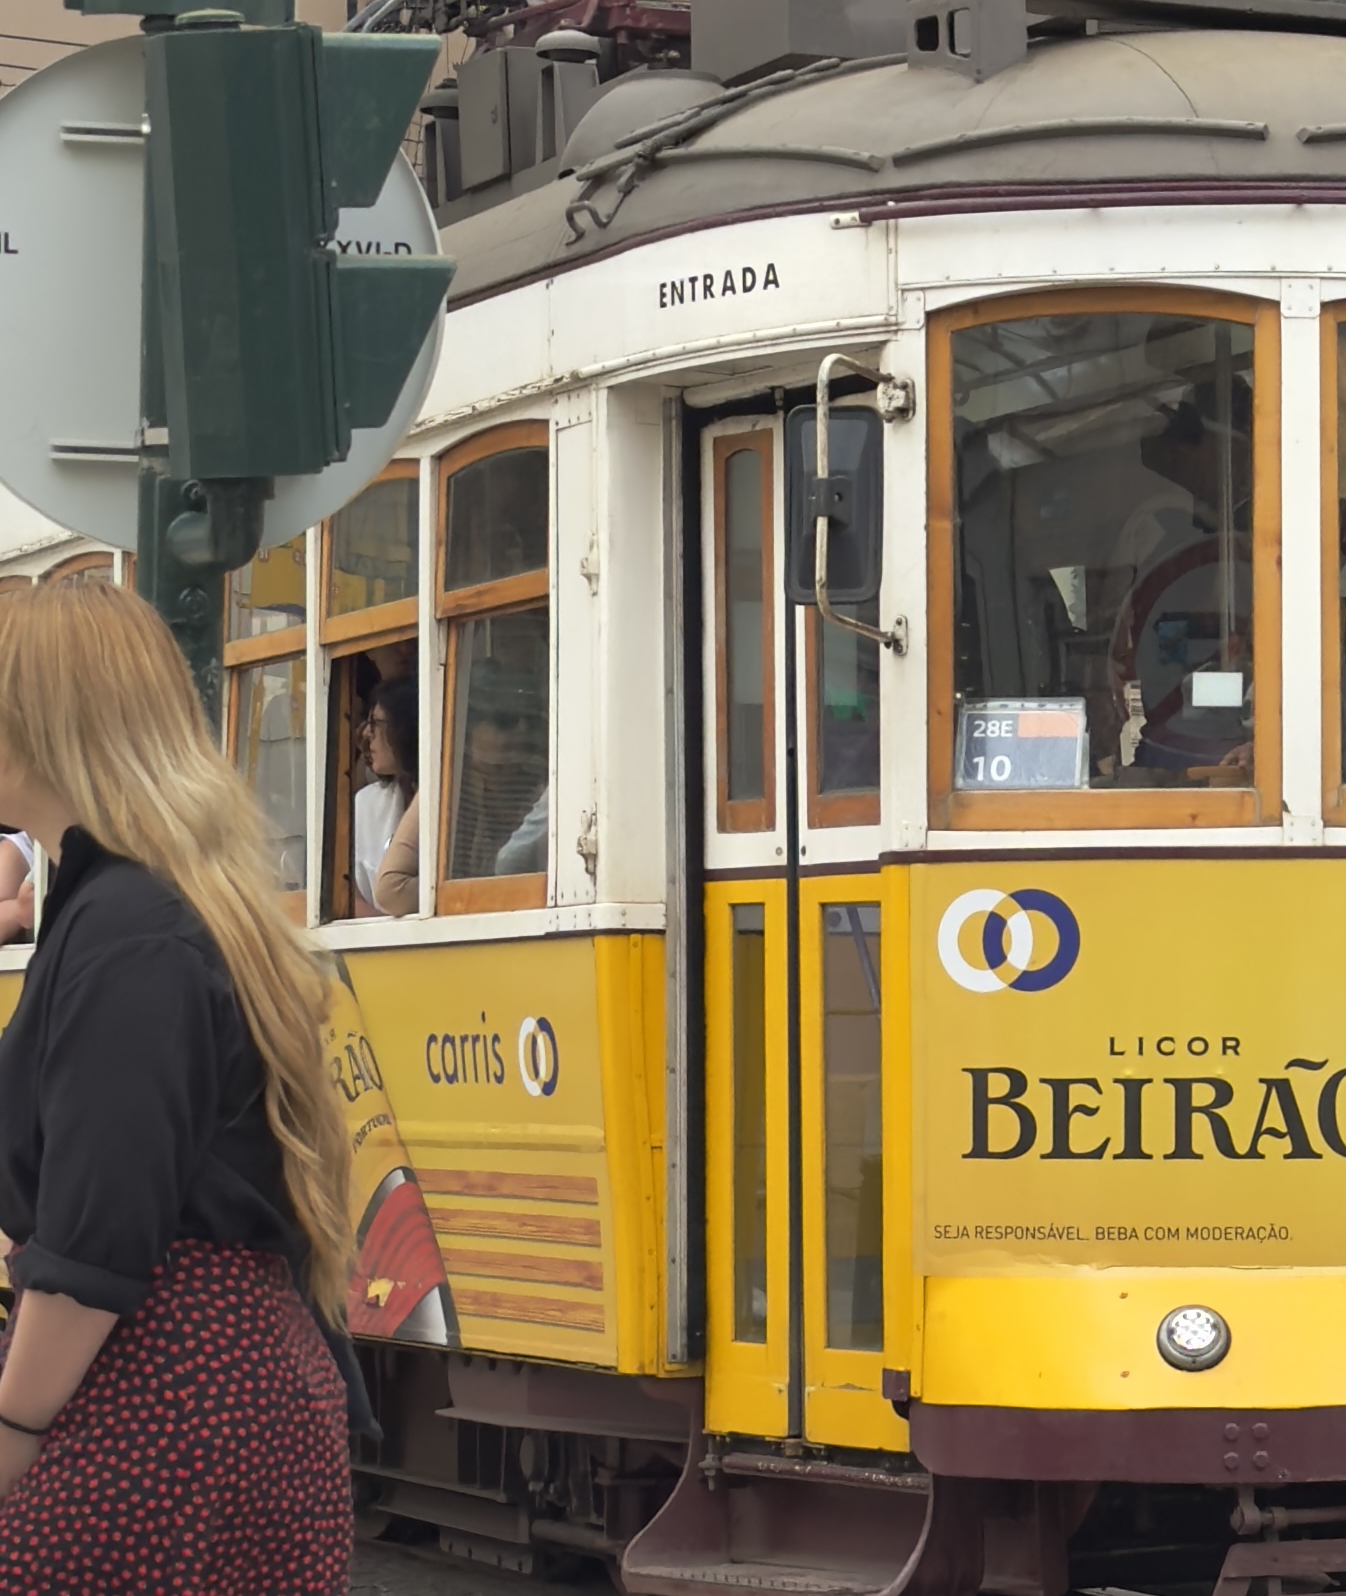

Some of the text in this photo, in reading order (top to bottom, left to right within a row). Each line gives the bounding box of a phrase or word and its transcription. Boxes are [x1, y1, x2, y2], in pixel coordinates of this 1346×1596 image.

[659, 263, 780, 309] ENTRADA
[973, 720, 1013, 738] 28E
[973, 755, 1012, 781] 10
[426, 1011, 505, 1085] carris
[1109, 1036, 1241, 1056] LICOR
[934, 1225, 970, 1239] SEJA
[974, 1222, 1089, 1241] RESPONSÁVEL.
[1095, 1226, 1139, 1241] BEBA
[1144, 1227, 1180, 1241] COM
